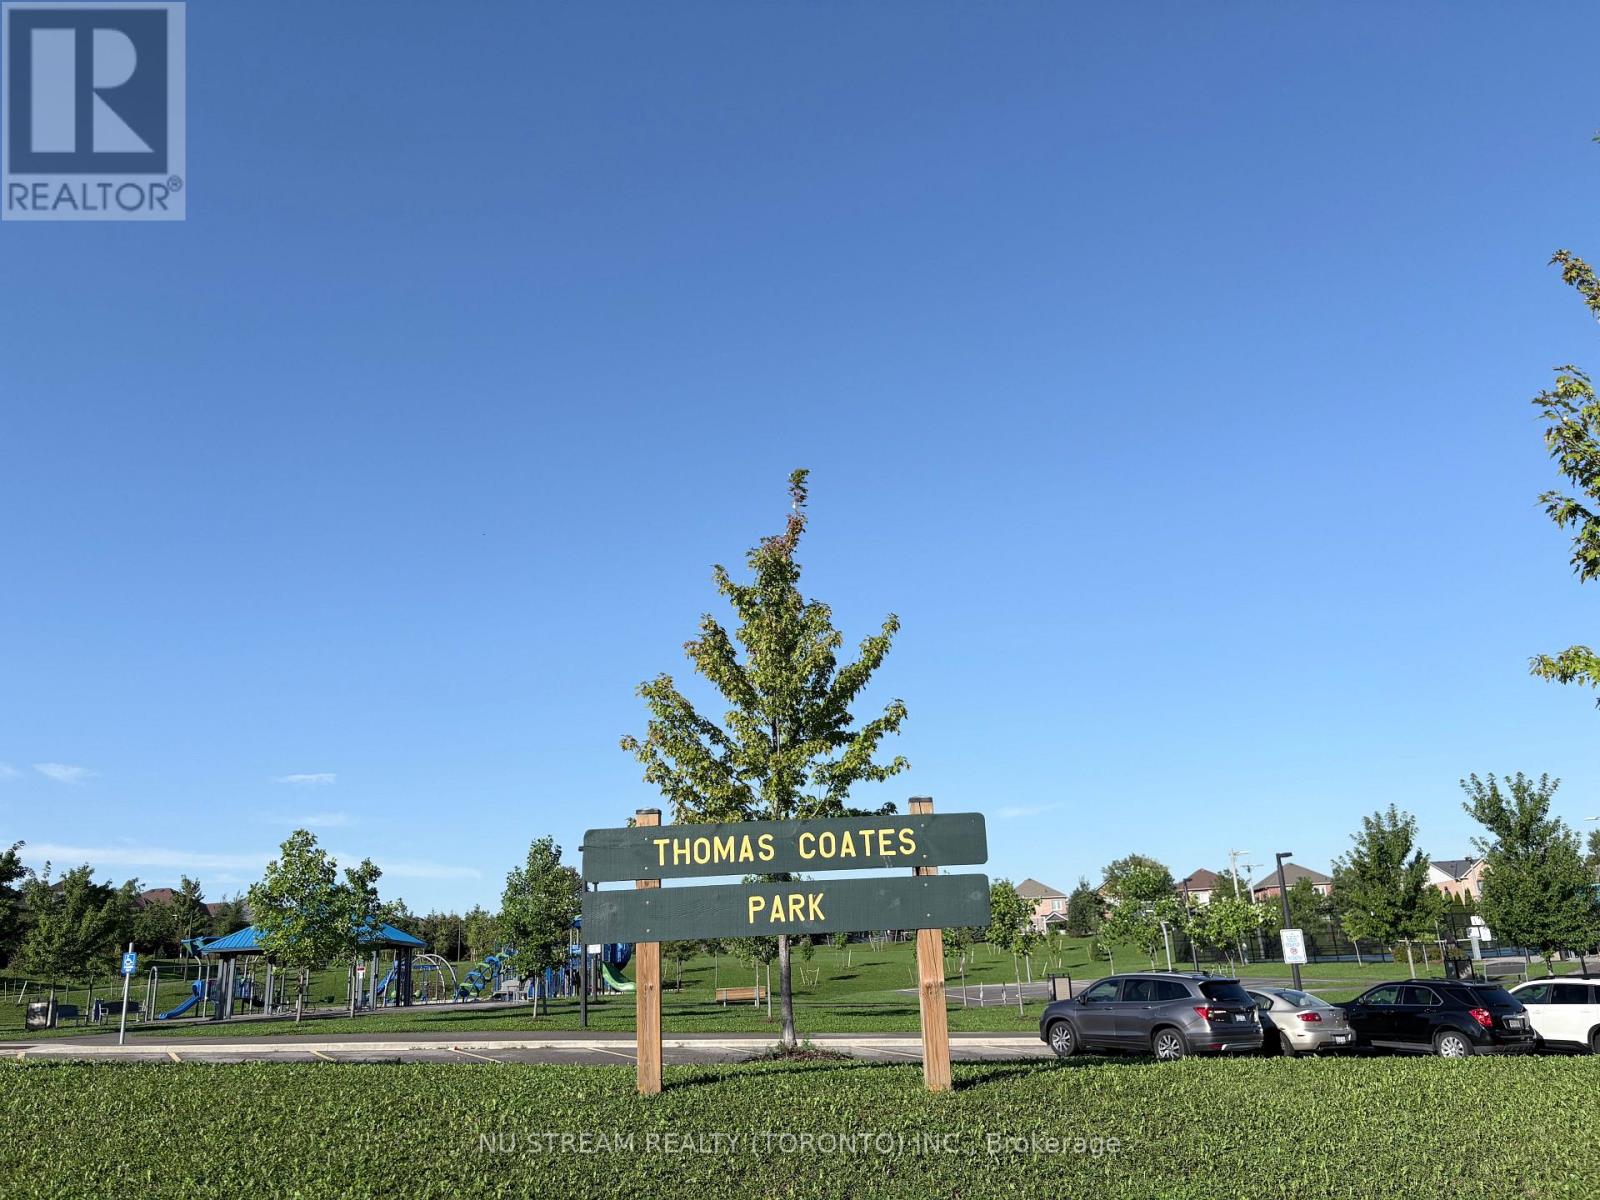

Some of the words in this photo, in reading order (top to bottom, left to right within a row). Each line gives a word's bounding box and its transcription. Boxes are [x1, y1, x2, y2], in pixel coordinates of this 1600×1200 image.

[652, 833, 775, 866] THOMAS
[798, 827, 917, 860] COATES
[748, 892, 826, 924] PARK
